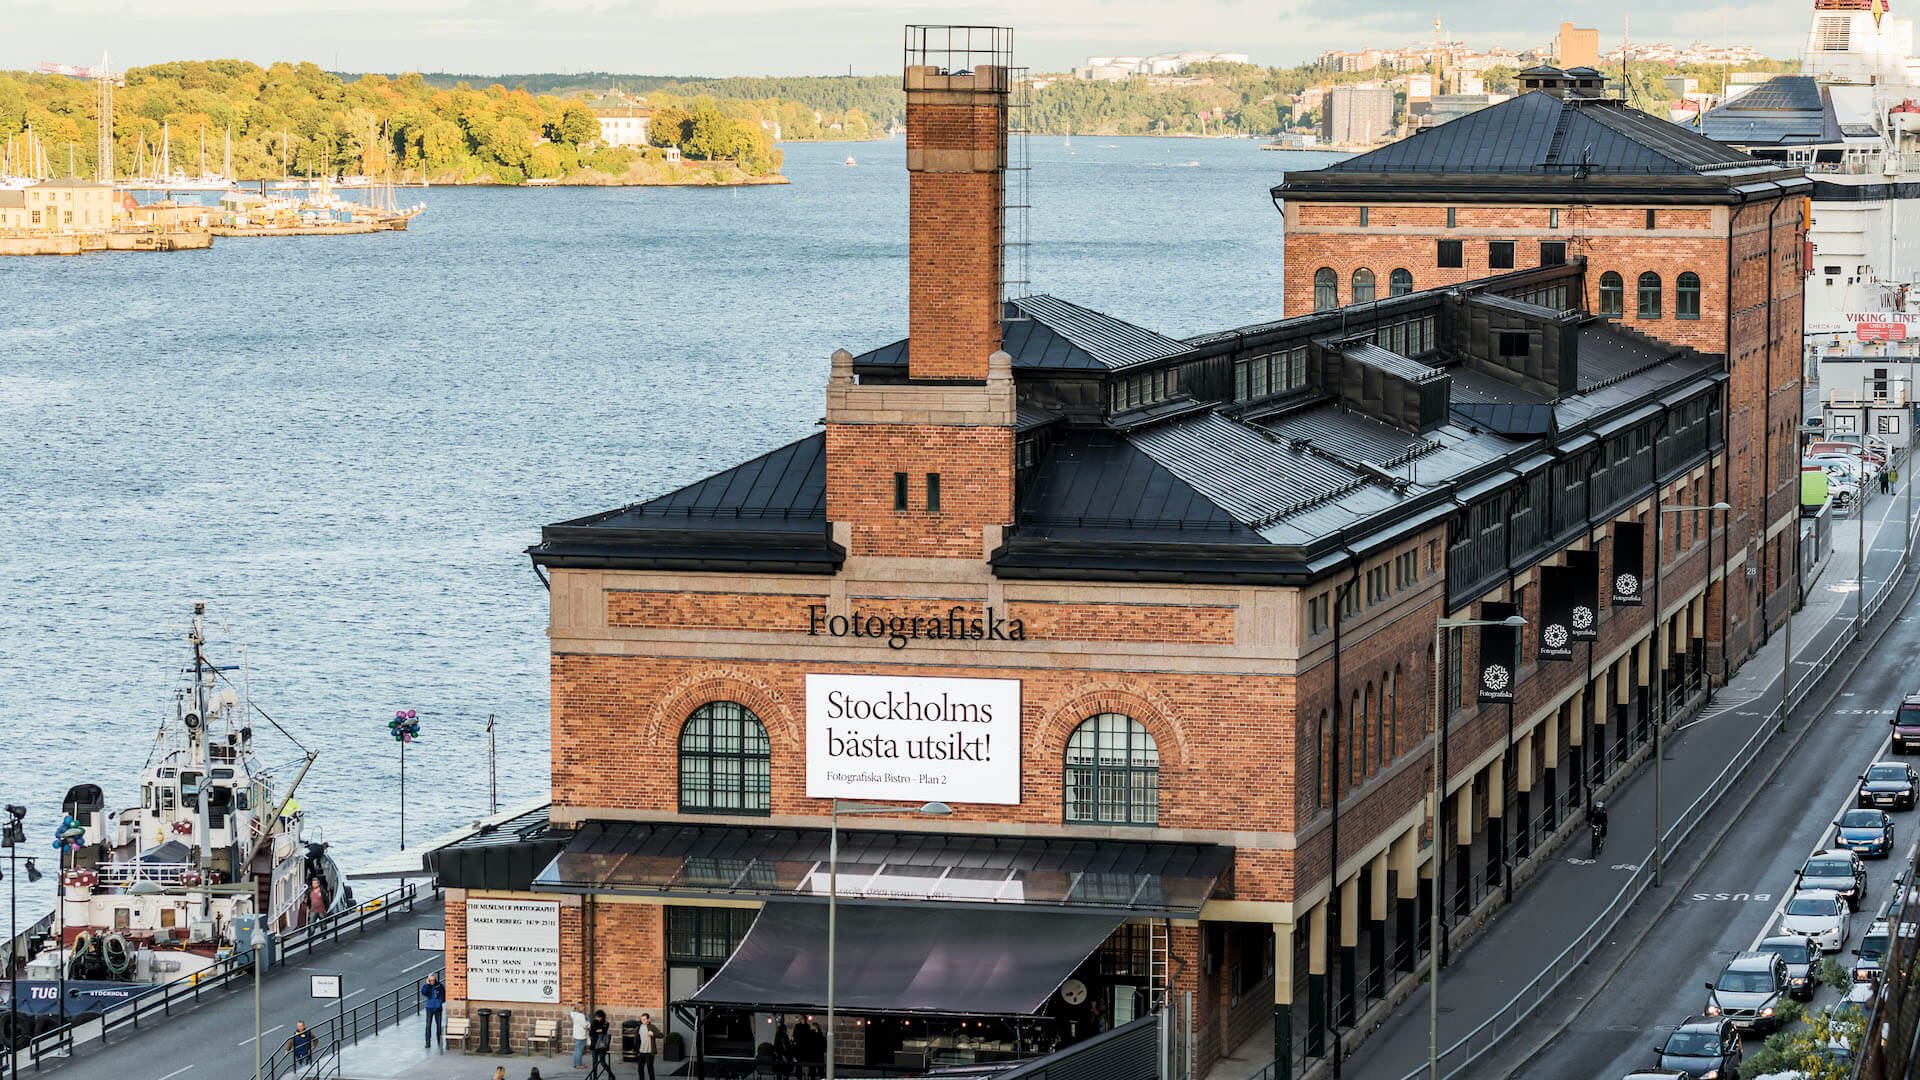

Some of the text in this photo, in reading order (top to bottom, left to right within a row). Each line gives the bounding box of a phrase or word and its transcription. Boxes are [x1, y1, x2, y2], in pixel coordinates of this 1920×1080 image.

[1846, 313, 1918, 323] VIKING LINE
[1746, 567, 1757, 576] 28
[807, 604, 1026, 650] Fotografiska
[1572, 629, 1597, 637] tografiska
[1540, 648, 1572, 656] Fotografiska
[1479, 689, 1513, 698] Fotografiska
[827, 690, 993, 724] Stockholms
[826, 727, 992, 762] bästa utsikt!
[826, 771, 882, 784] Fotografiska
[884, 772, 911, 784] Bistro
[919, 774, 940, 785] Plan
[941, 775, 947, 785] 2
[1692, 893, 1772, 902] BUSS
[513, 905, 556, 913] PHOTOGRAPHY
[30, 987, 58, 999] TUG
